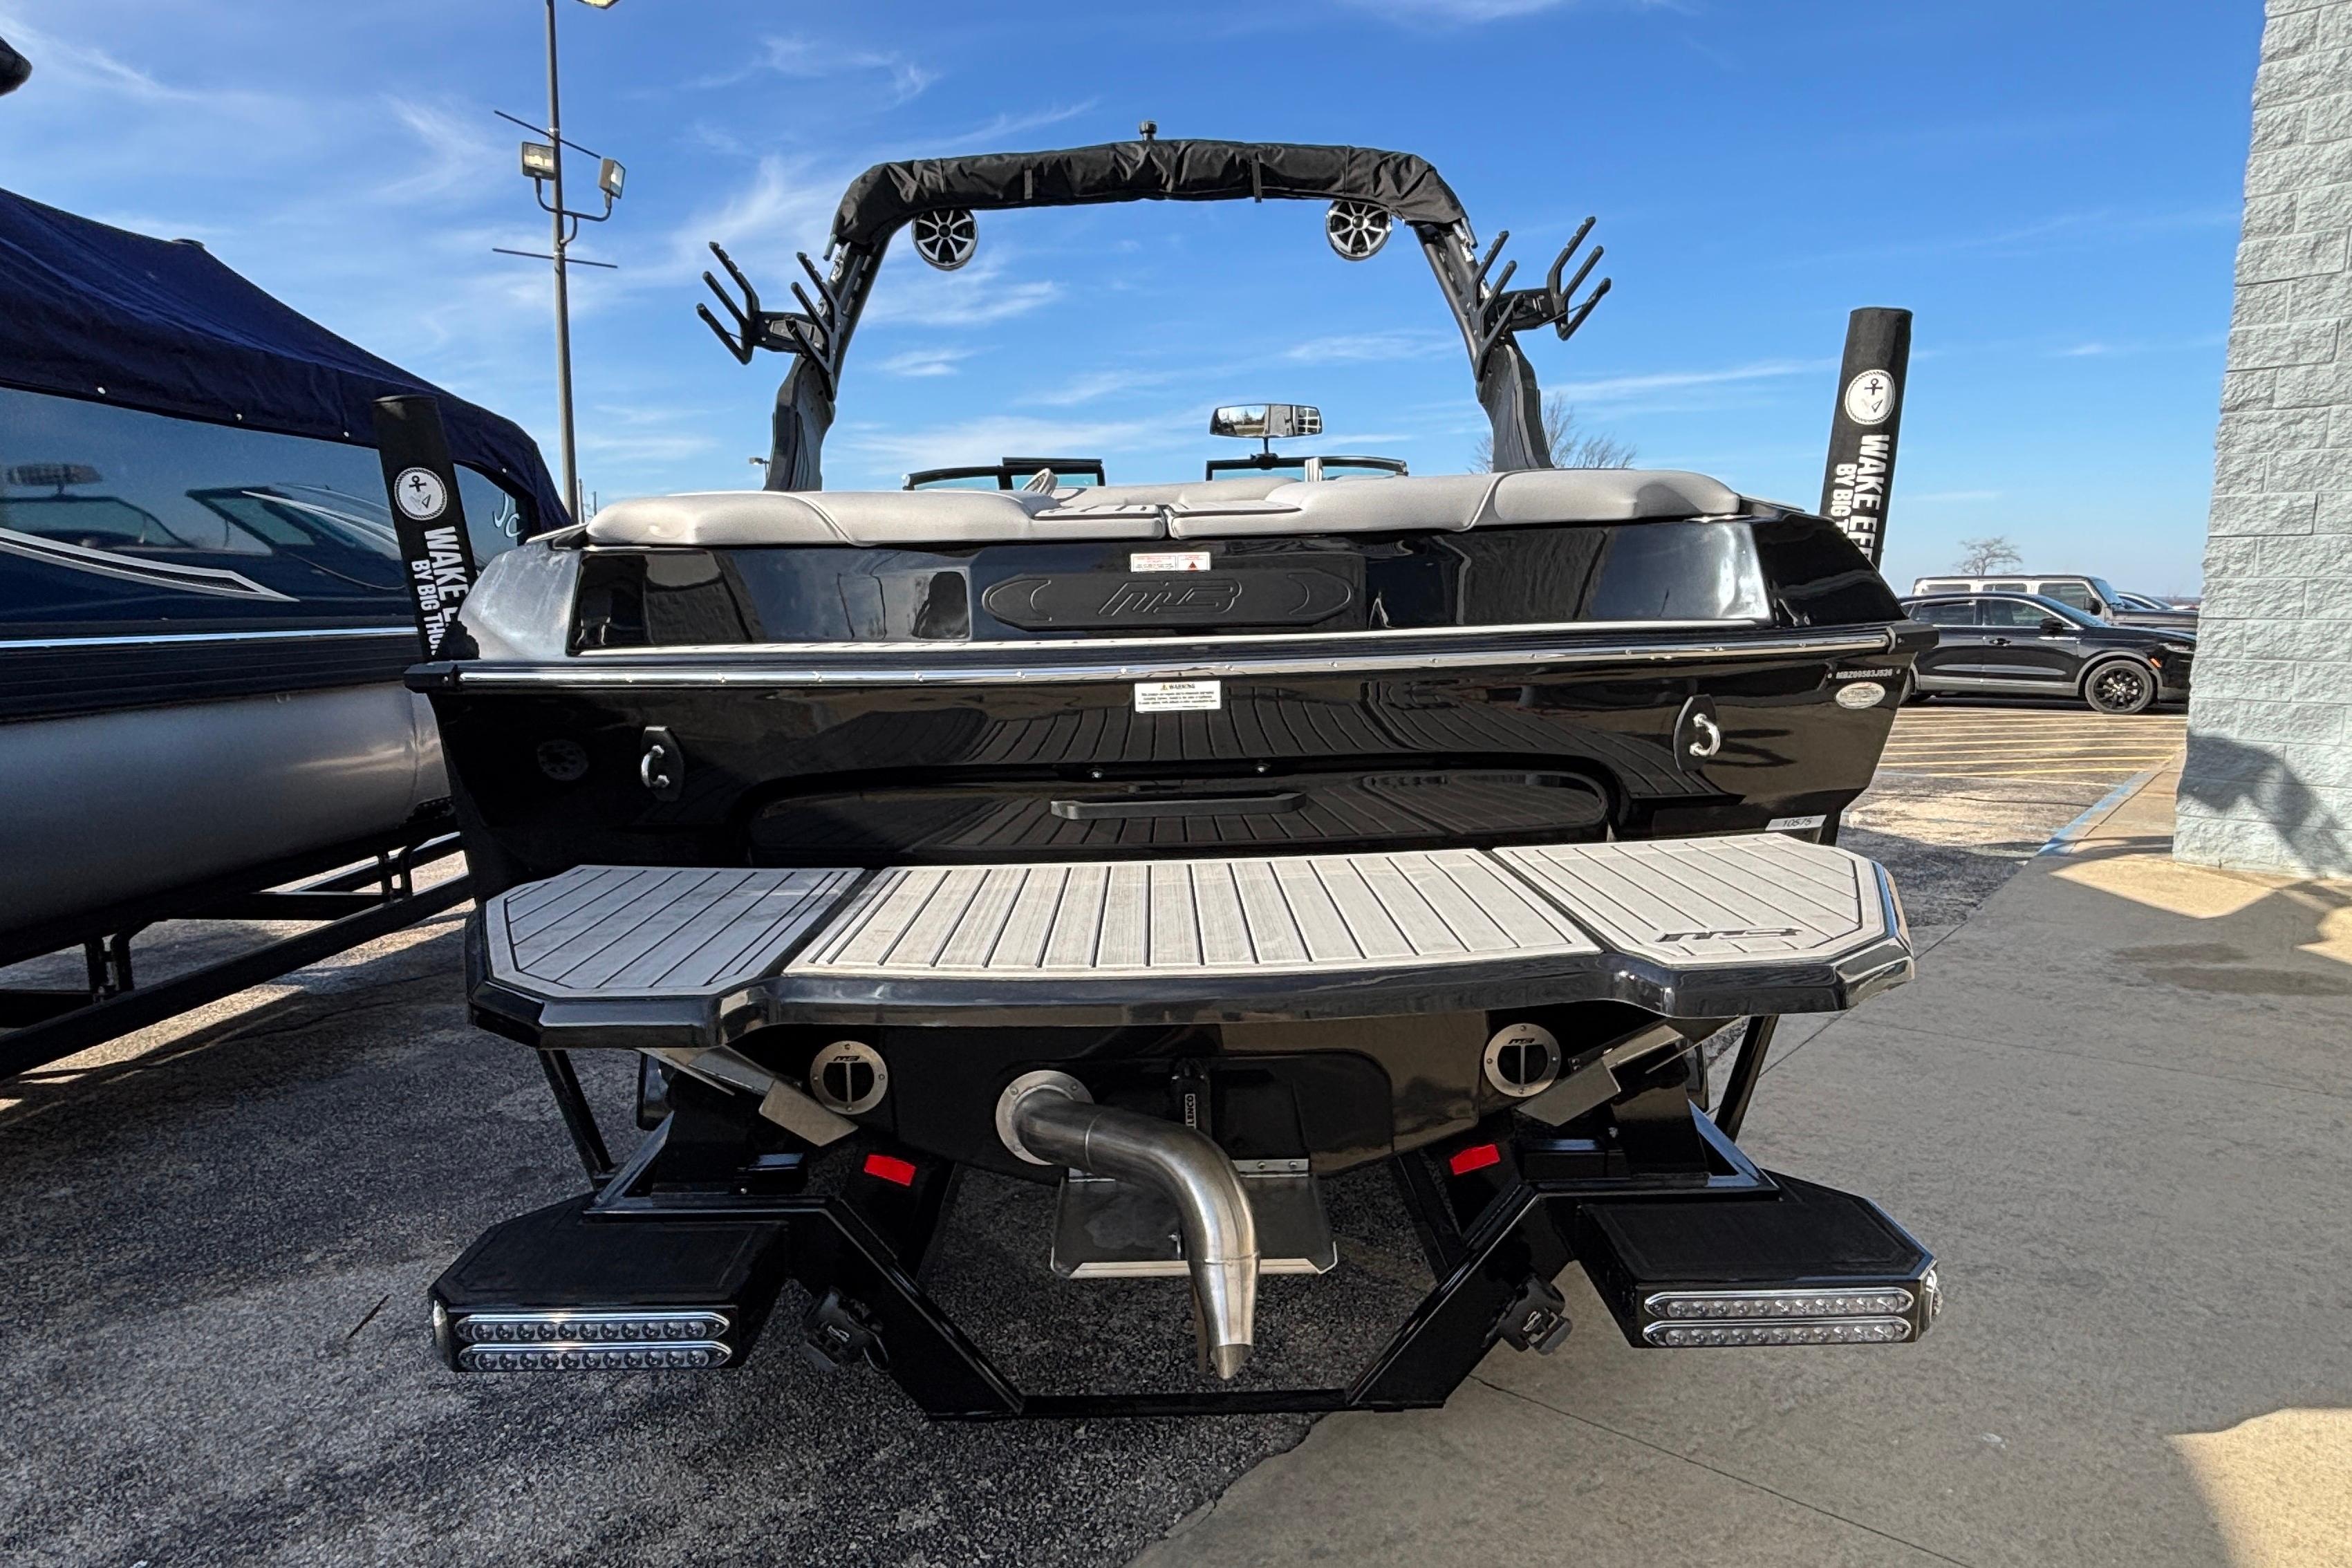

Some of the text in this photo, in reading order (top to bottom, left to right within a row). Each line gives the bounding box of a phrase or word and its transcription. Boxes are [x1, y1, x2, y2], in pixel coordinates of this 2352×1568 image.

[1834, 463, 1858, 487] BY
[1851, 434, 1890, 510] WAKE
[1830, 489, 1854, 517] BIG
[411, 559, 434, 581] BY
[424, 525, 469, 601] WAKE
[416, 584, 440, 611] BIG
[1186, 1095, 1195, 1125] LENCO
